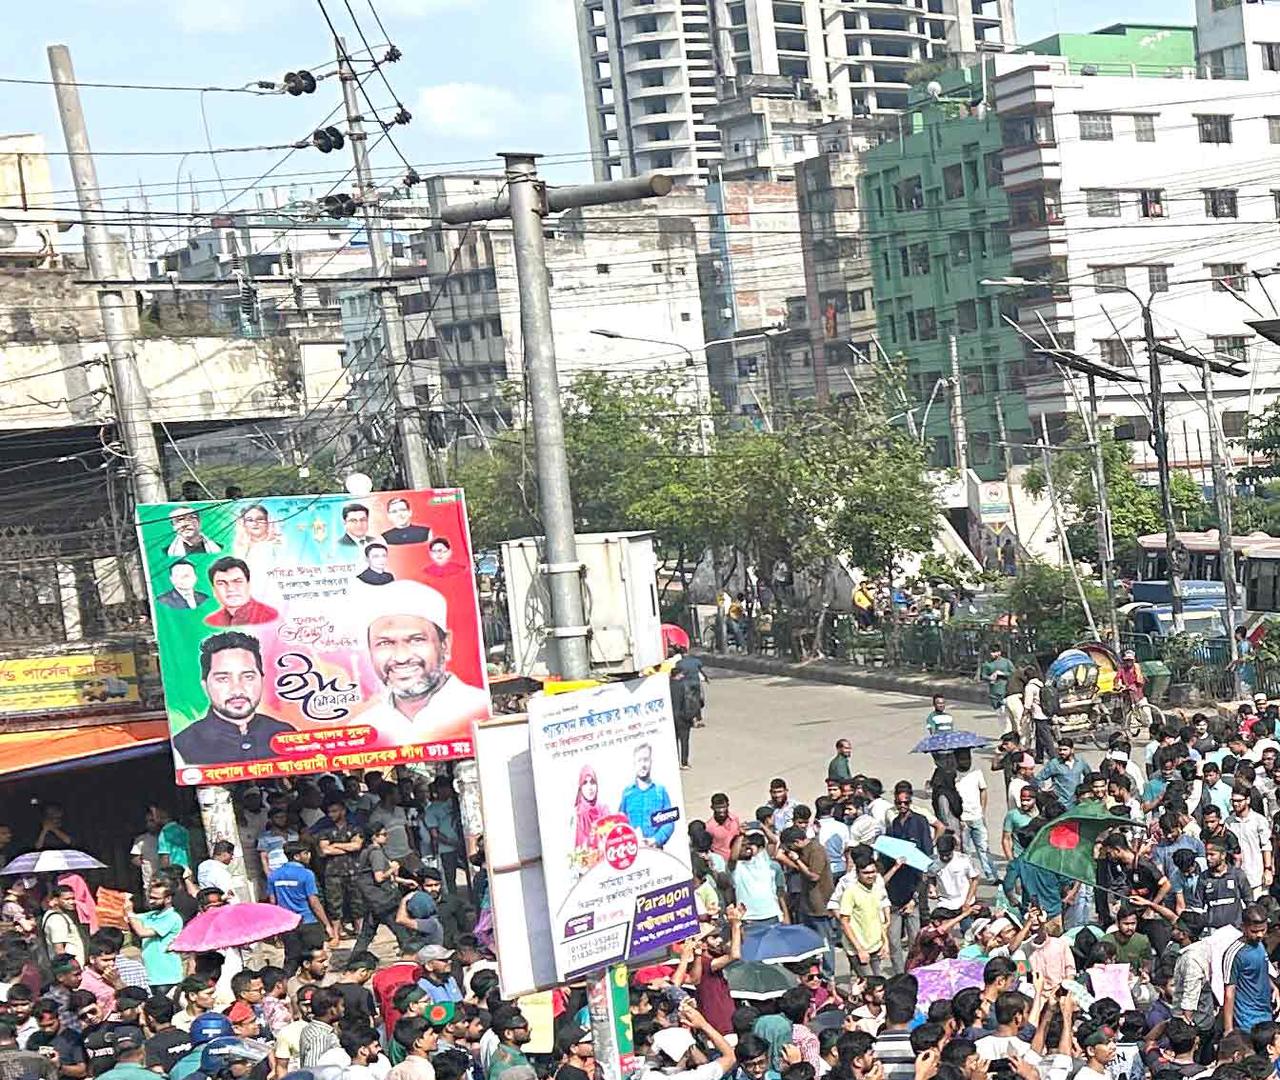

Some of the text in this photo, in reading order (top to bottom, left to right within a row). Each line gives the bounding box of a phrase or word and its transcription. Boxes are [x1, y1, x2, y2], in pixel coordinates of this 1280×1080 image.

[22, 661, 70, 680] পার্সেল
[247, 762, 274, 776] থানা
[278, 755, 328, 774] আওয়ামী
[636, 886, 690, 914] Paragon
